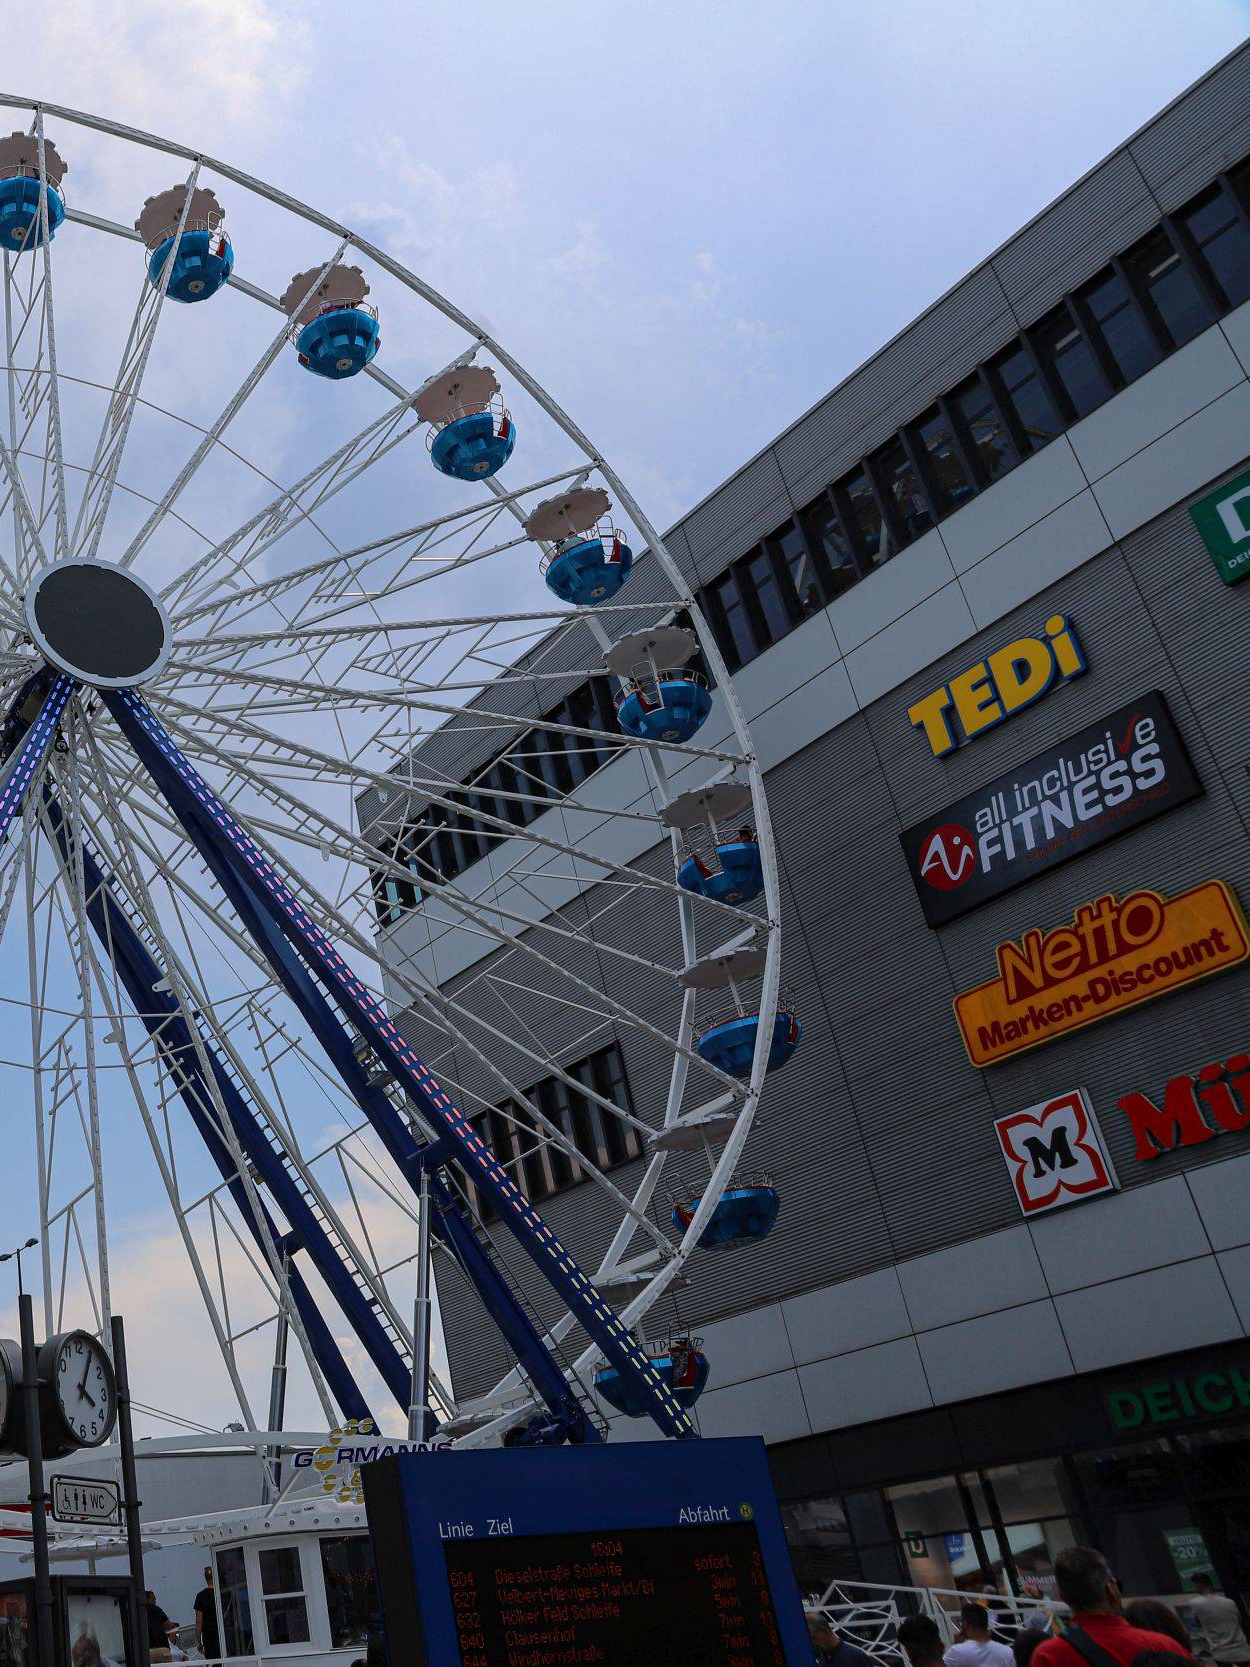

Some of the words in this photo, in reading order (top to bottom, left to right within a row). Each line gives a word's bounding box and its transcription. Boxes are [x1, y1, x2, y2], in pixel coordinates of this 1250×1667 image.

[1228, 550, 1250, 568] DEI
[906, 613, 1088, 759] TEDi
[975, 791, 1007, 833] all
[1014, 716, 1156, 812] inclusive
[978, 743, 1166, 873] FITNESS
[1001, 891, 1162, 1004] Netto
[977, 927, 1230, 1051] Marken-Discount
[1022, 1125, 1079, 1179] M
[65, 1344, 72, 1359] 11
[74, 1340, 83, 1355] 12
[96, 1366, 102, 1380] 2
[100, 1388, 107, 1402] 3
[98, 1408, 105, 1422] 4
[79, 1424, 87, 1439] 6
[90, 1421, 98, 1436] 5
[90, 1493, 105, 1510] WC
[679, 1505, 731, 1524] Abfahrt
[439, 1520, 474, 1538] Linie
[486, 1517, 514, 1536] Ziel
[693, 1553, 734, 1571] sofort
